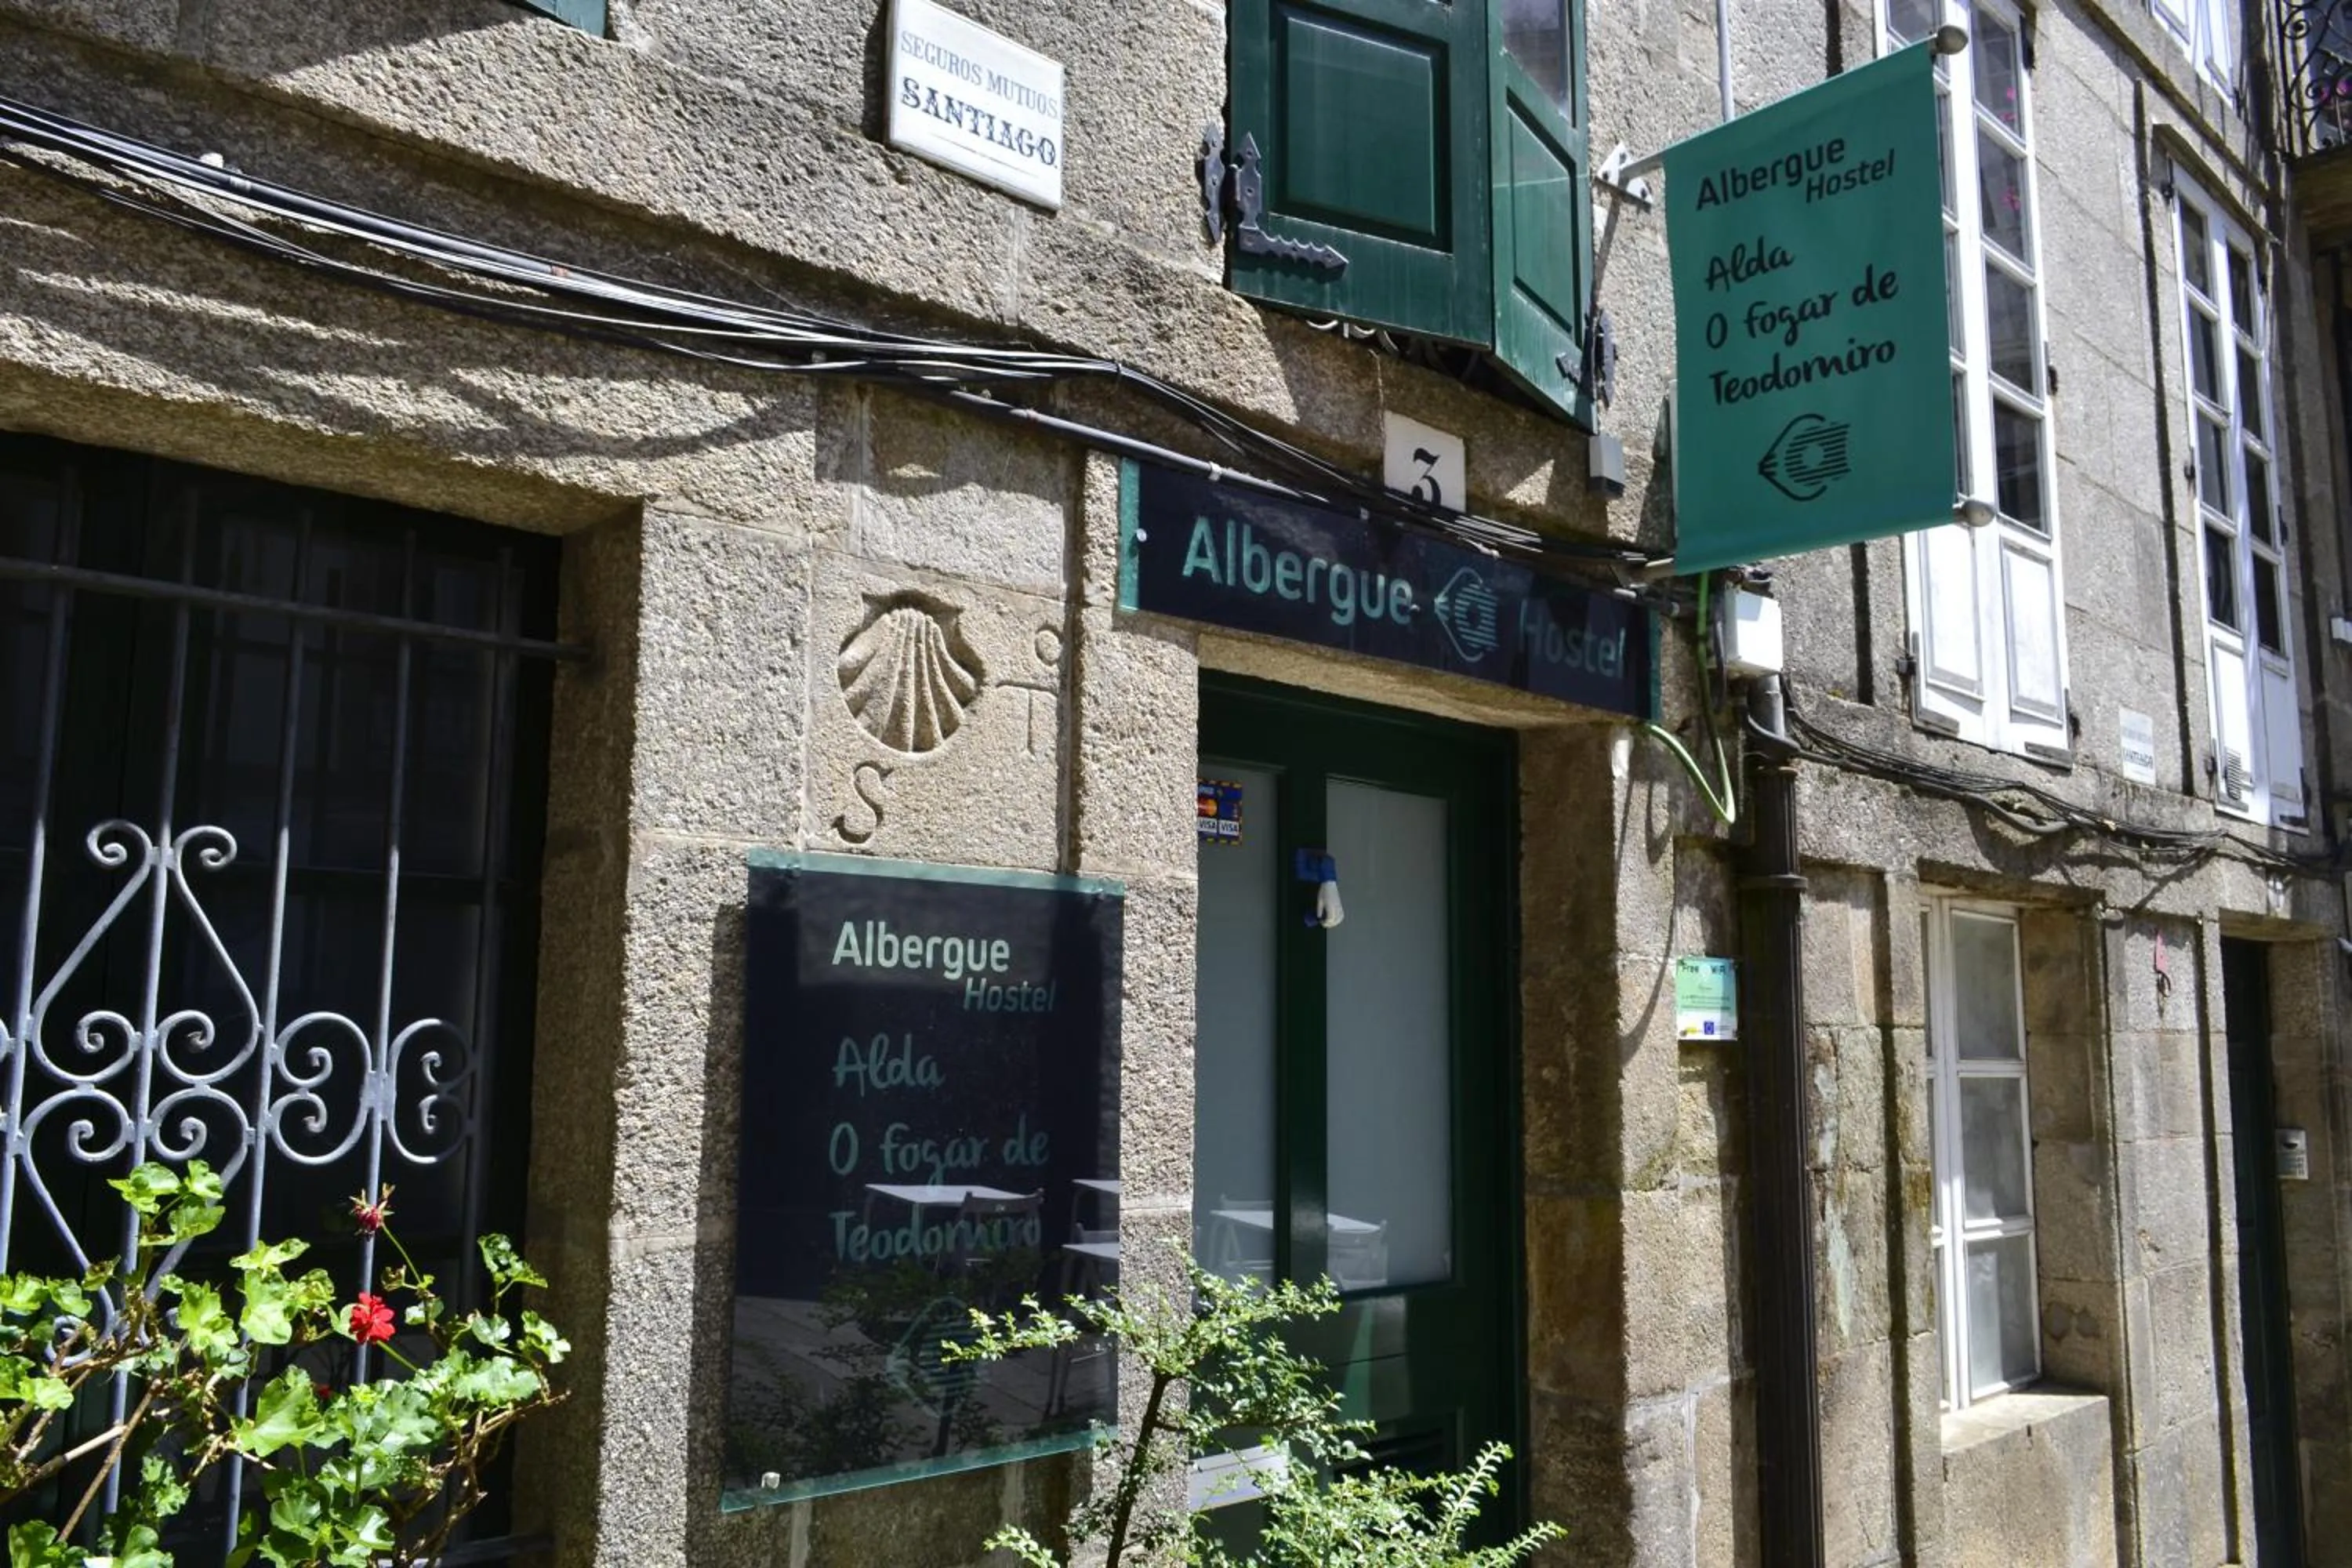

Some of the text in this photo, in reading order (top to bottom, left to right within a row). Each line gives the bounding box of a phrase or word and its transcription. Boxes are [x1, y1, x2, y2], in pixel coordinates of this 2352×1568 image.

[901, 30, 1058, 120] SEGUROS MUTUOS
[1695, 137, 1846, 210] Albergue
[1805, 148, 1896, 204] Hostel
[1705, 235, 1795, 293] Alda
[1705, 264, 1899, 349] O fogar de
[1709, 336, 1896, 405] Teodomiro
[1411, 448, 1441, 506] 3
[1182, 516, 1624, 678] Albergue Hostel
[1221, 823, 1239, 833] VISA
[832, 920, 1011, 980] Albergue
[963, 977, 1056, 1012] Hostel
[832, 1033, 945, 1097] Alda
[829, 1113, 1050, 1195] O fogar de
[828, 1202, 1041, 1261] Teodomiro
